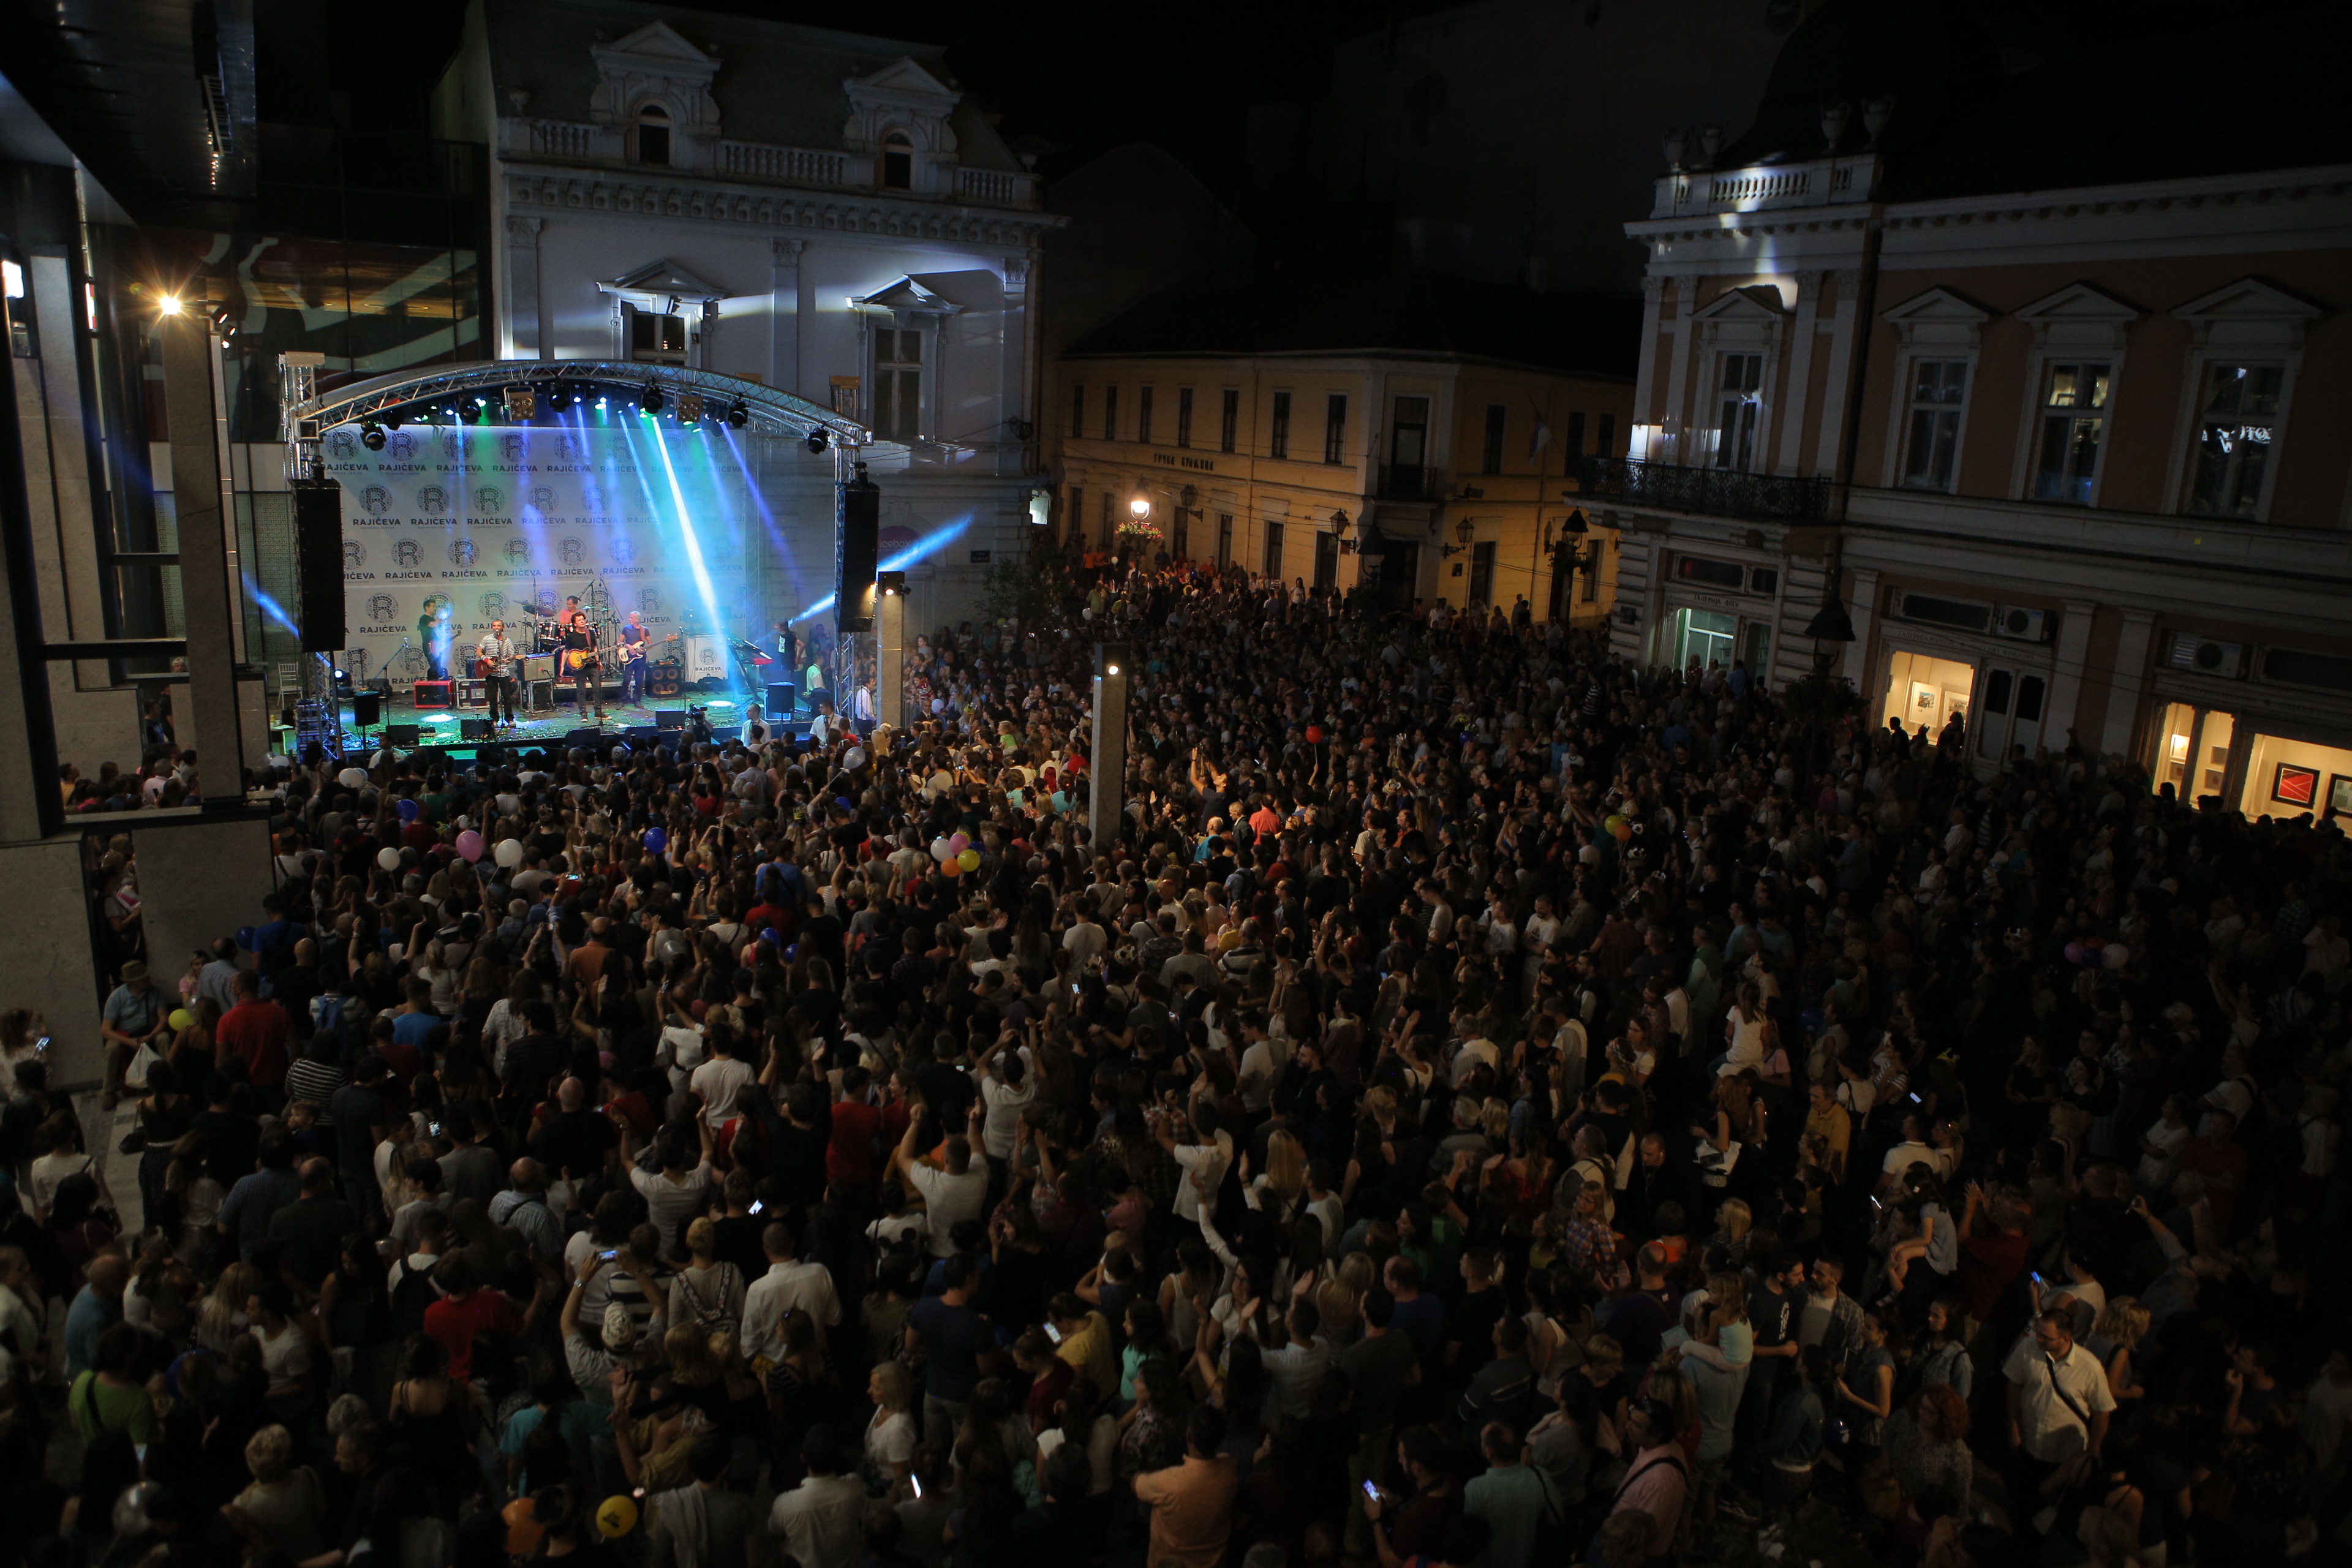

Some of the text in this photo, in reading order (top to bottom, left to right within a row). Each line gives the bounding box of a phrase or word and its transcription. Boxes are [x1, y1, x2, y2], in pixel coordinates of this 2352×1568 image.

[1154, 453, 1175, 466] ГРЧКА
[379, 462, 426, 471] RAJIĆEVA
[492, 463, 538, 472] RAJIĆEVA
[353, 516, 401, 526] RAJIĆEVA
[411, 516, 458, 525] RAJIĆEVA
[467, 516, 513, 525] RAJIĆEVA
[522, 516, 567, 524] RAJIĆEVA
[385, 570, 432, 579] RAJIĆEVA
[442, 569, 488, 578] RAJIĆEVA
[497, 568, 541, 576] RAJIĆEVA
[551, 567, 594, 575] RAJIĆEVA
[1694, 594, 1740, 608] ГАЛЕРИЈА ФЛУ
[360, 624, 407, 633] RAJIĆEVA
